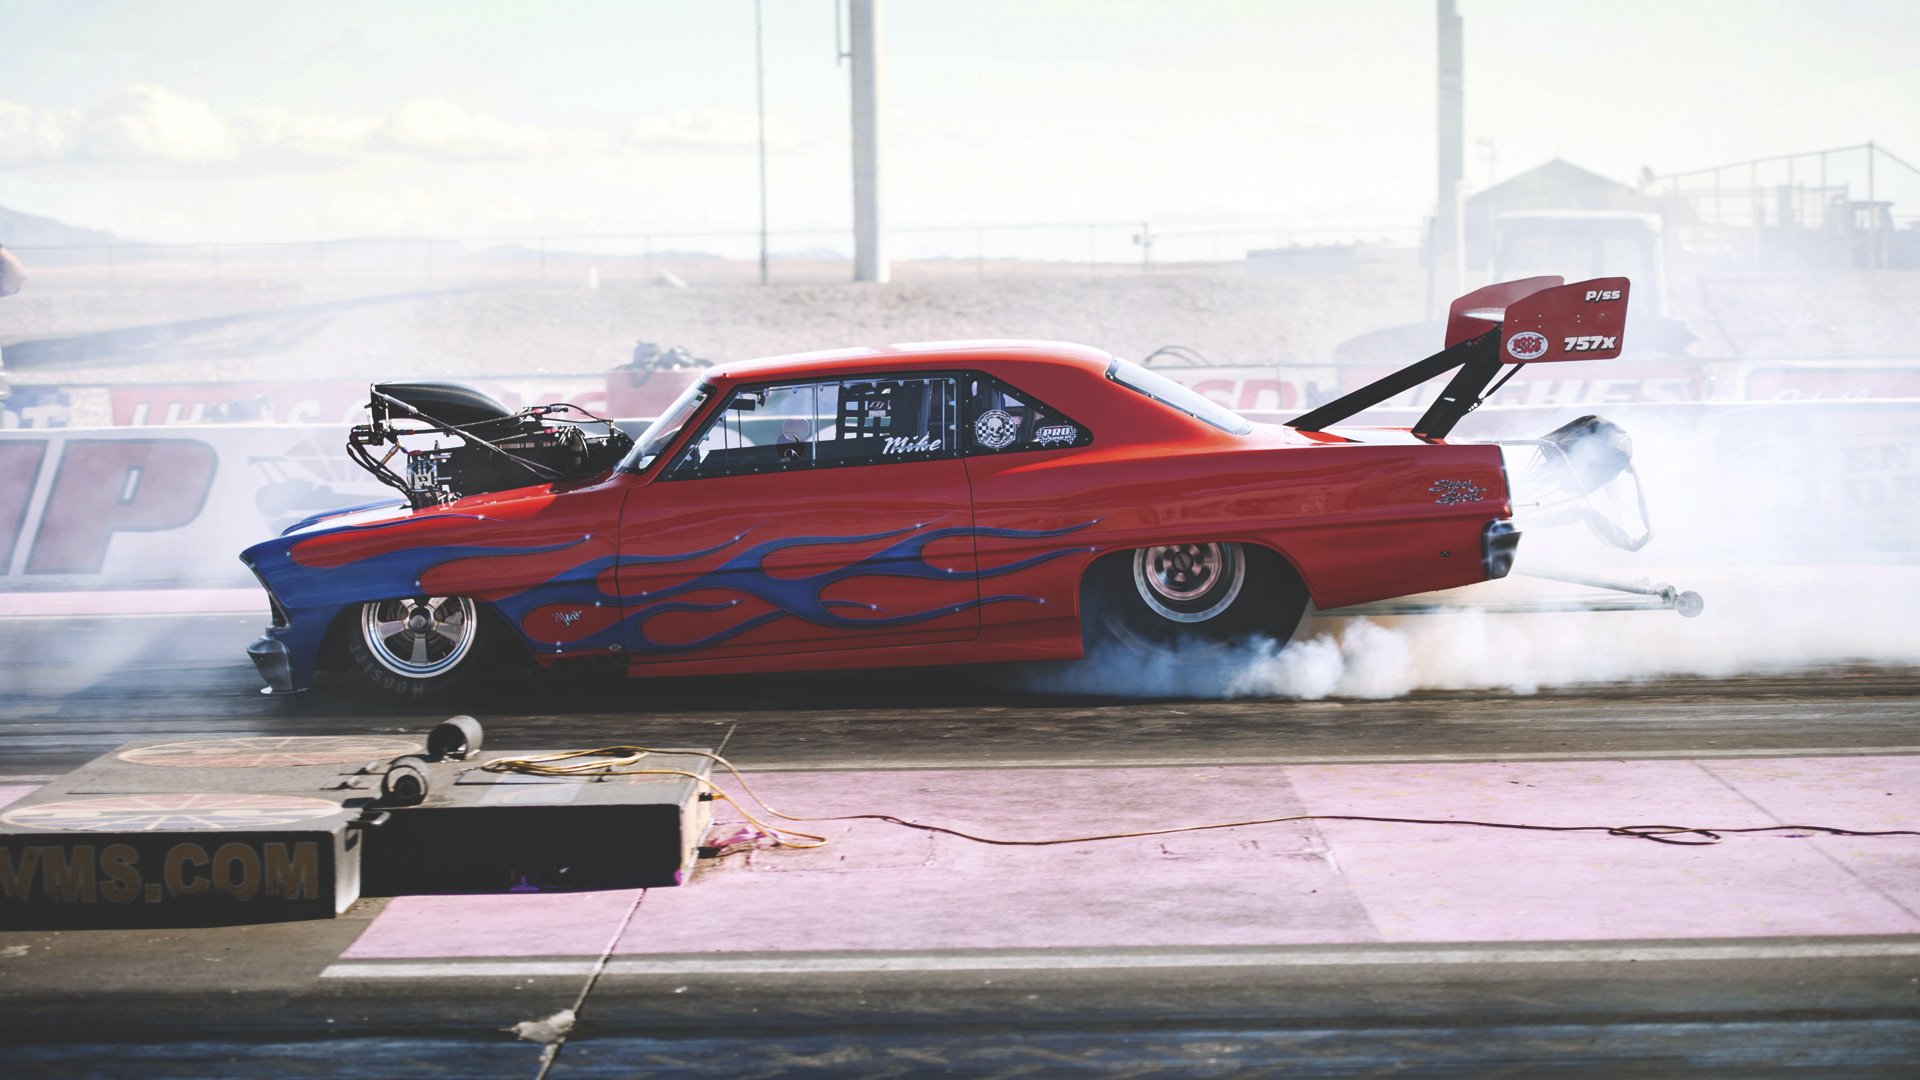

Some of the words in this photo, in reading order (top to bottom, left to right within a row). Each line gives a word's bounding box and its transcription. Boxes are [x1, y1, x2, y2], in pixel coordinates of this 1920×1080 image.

[1563, 335, 1617, 352] 757X
[1042, 427, 1070, 437] PRO
[882, 431, 942, 455] Mike
[1428, 479, 1486, 493] Super
[1435, 491, 1484, 506] Sport
